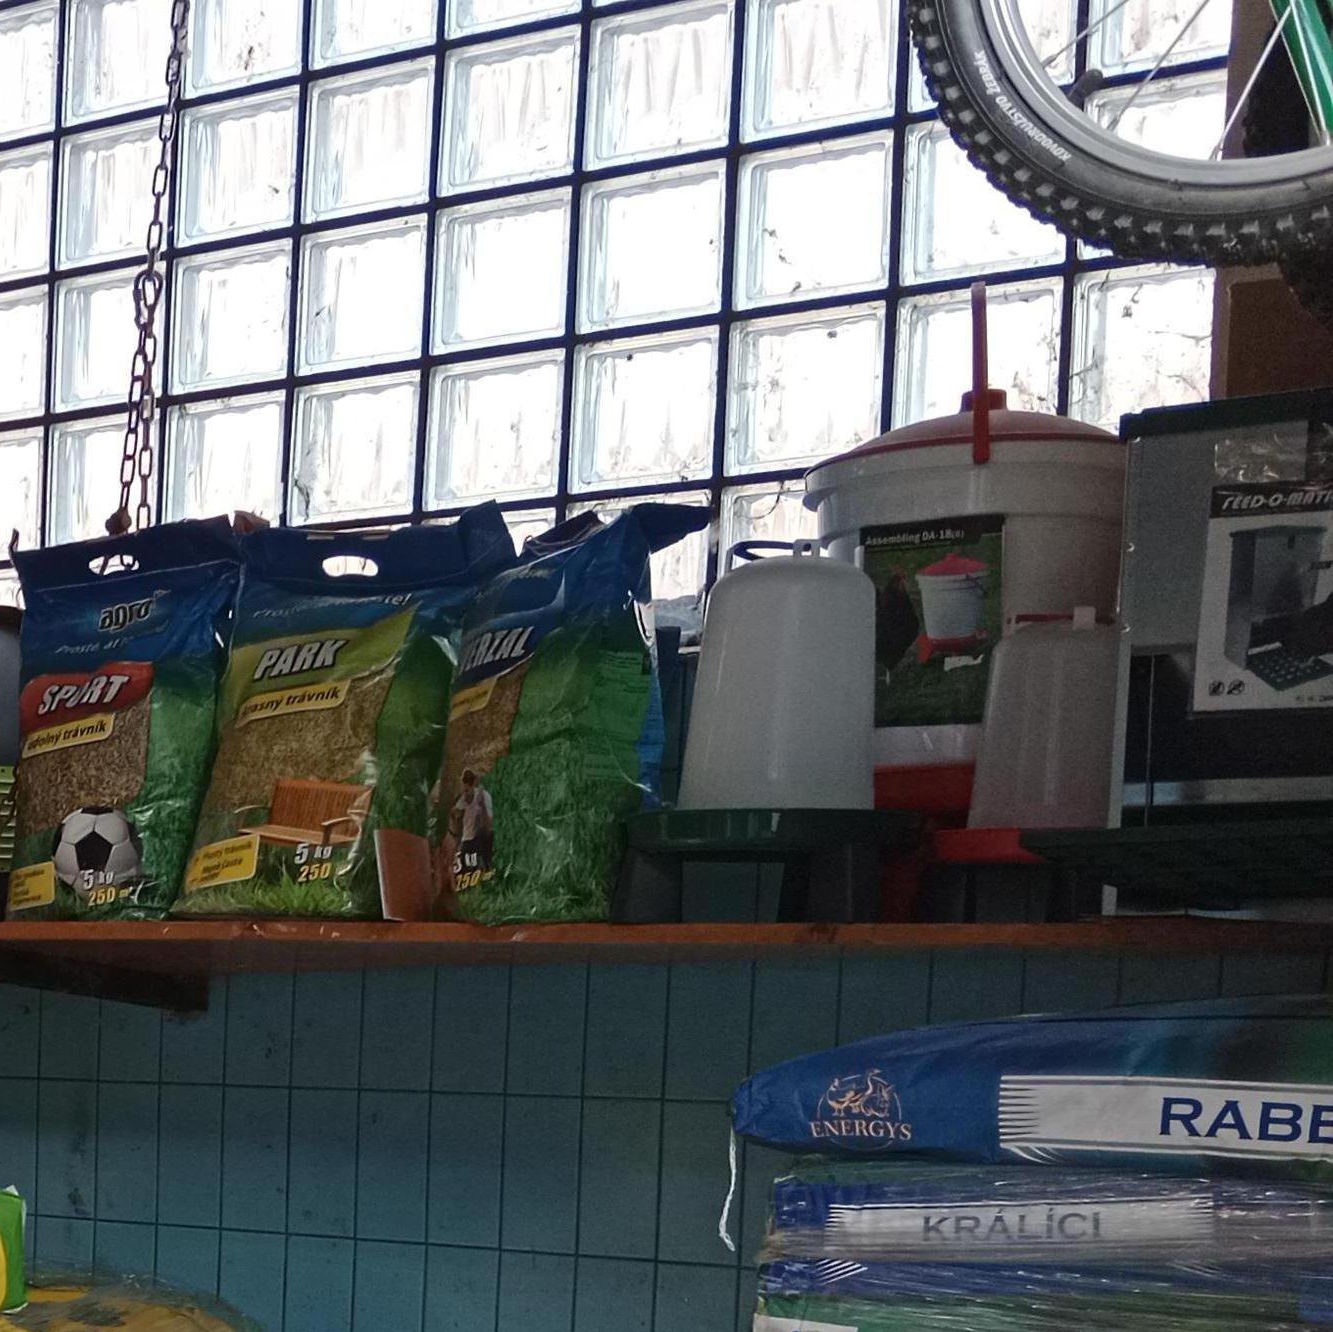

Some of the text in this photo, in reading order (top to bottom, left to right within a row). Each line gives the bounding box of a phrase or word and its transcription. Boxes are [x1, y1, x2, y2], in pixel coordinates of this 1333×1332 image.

[865, 532, 921, 546] Assembling
[98, 597, 153, 632] agro
[253, 639, 349, 682] PARK
[283, 688, 341, 707] trávník
[294, 843, 308, 864] 5
[83, 869, 96, 889] 5
[297, 863, 332, 883] 250
[86, 886, 116, 907] 250
[809, 1118, 913, 1142] ENERGYS
[921, 1205, 1103, 1245] KRÁLÍCI
